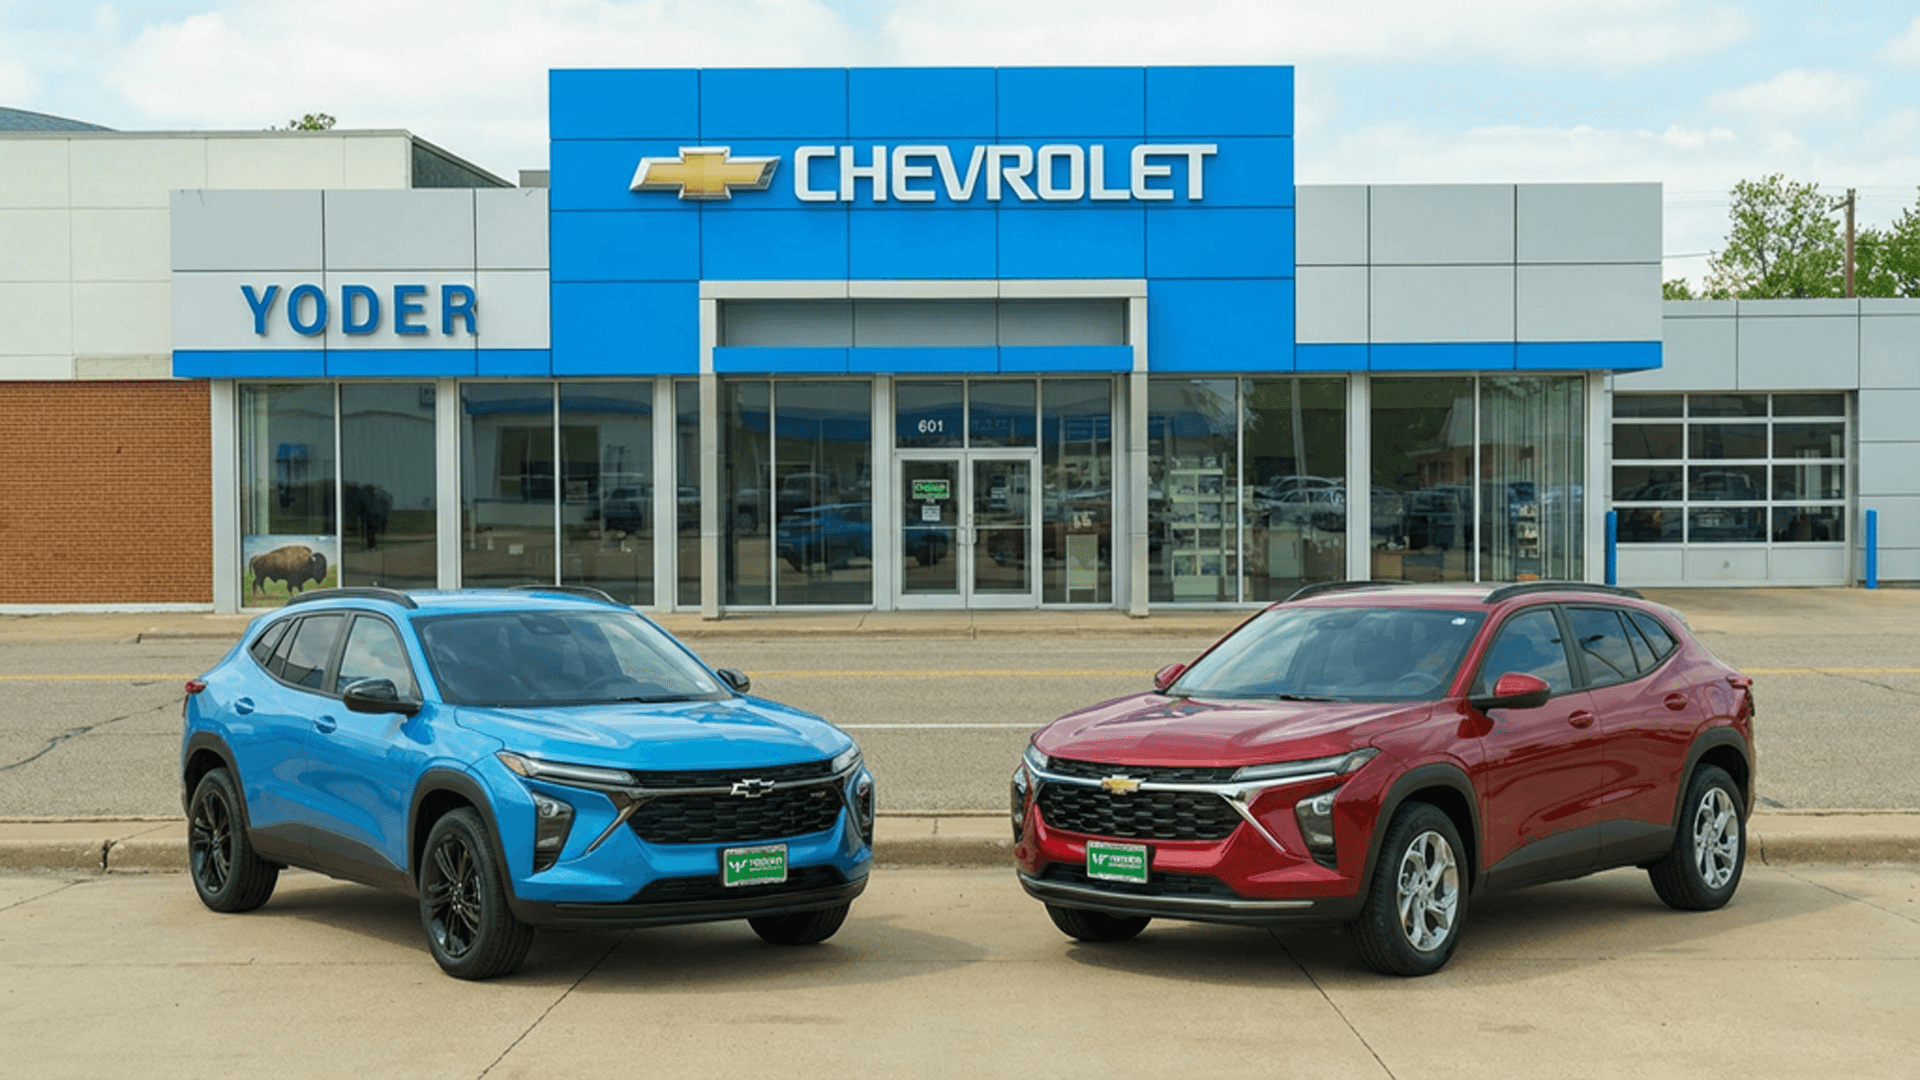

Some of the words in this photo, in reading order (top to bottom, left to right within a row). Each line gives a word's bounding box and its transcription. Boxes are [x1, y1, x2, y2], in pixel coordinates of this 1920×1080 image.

[795, 144, 1218, 201] CHEVROLET
[241, 284, 478, 336] YODER
[918, 420, 943, 433] 601
